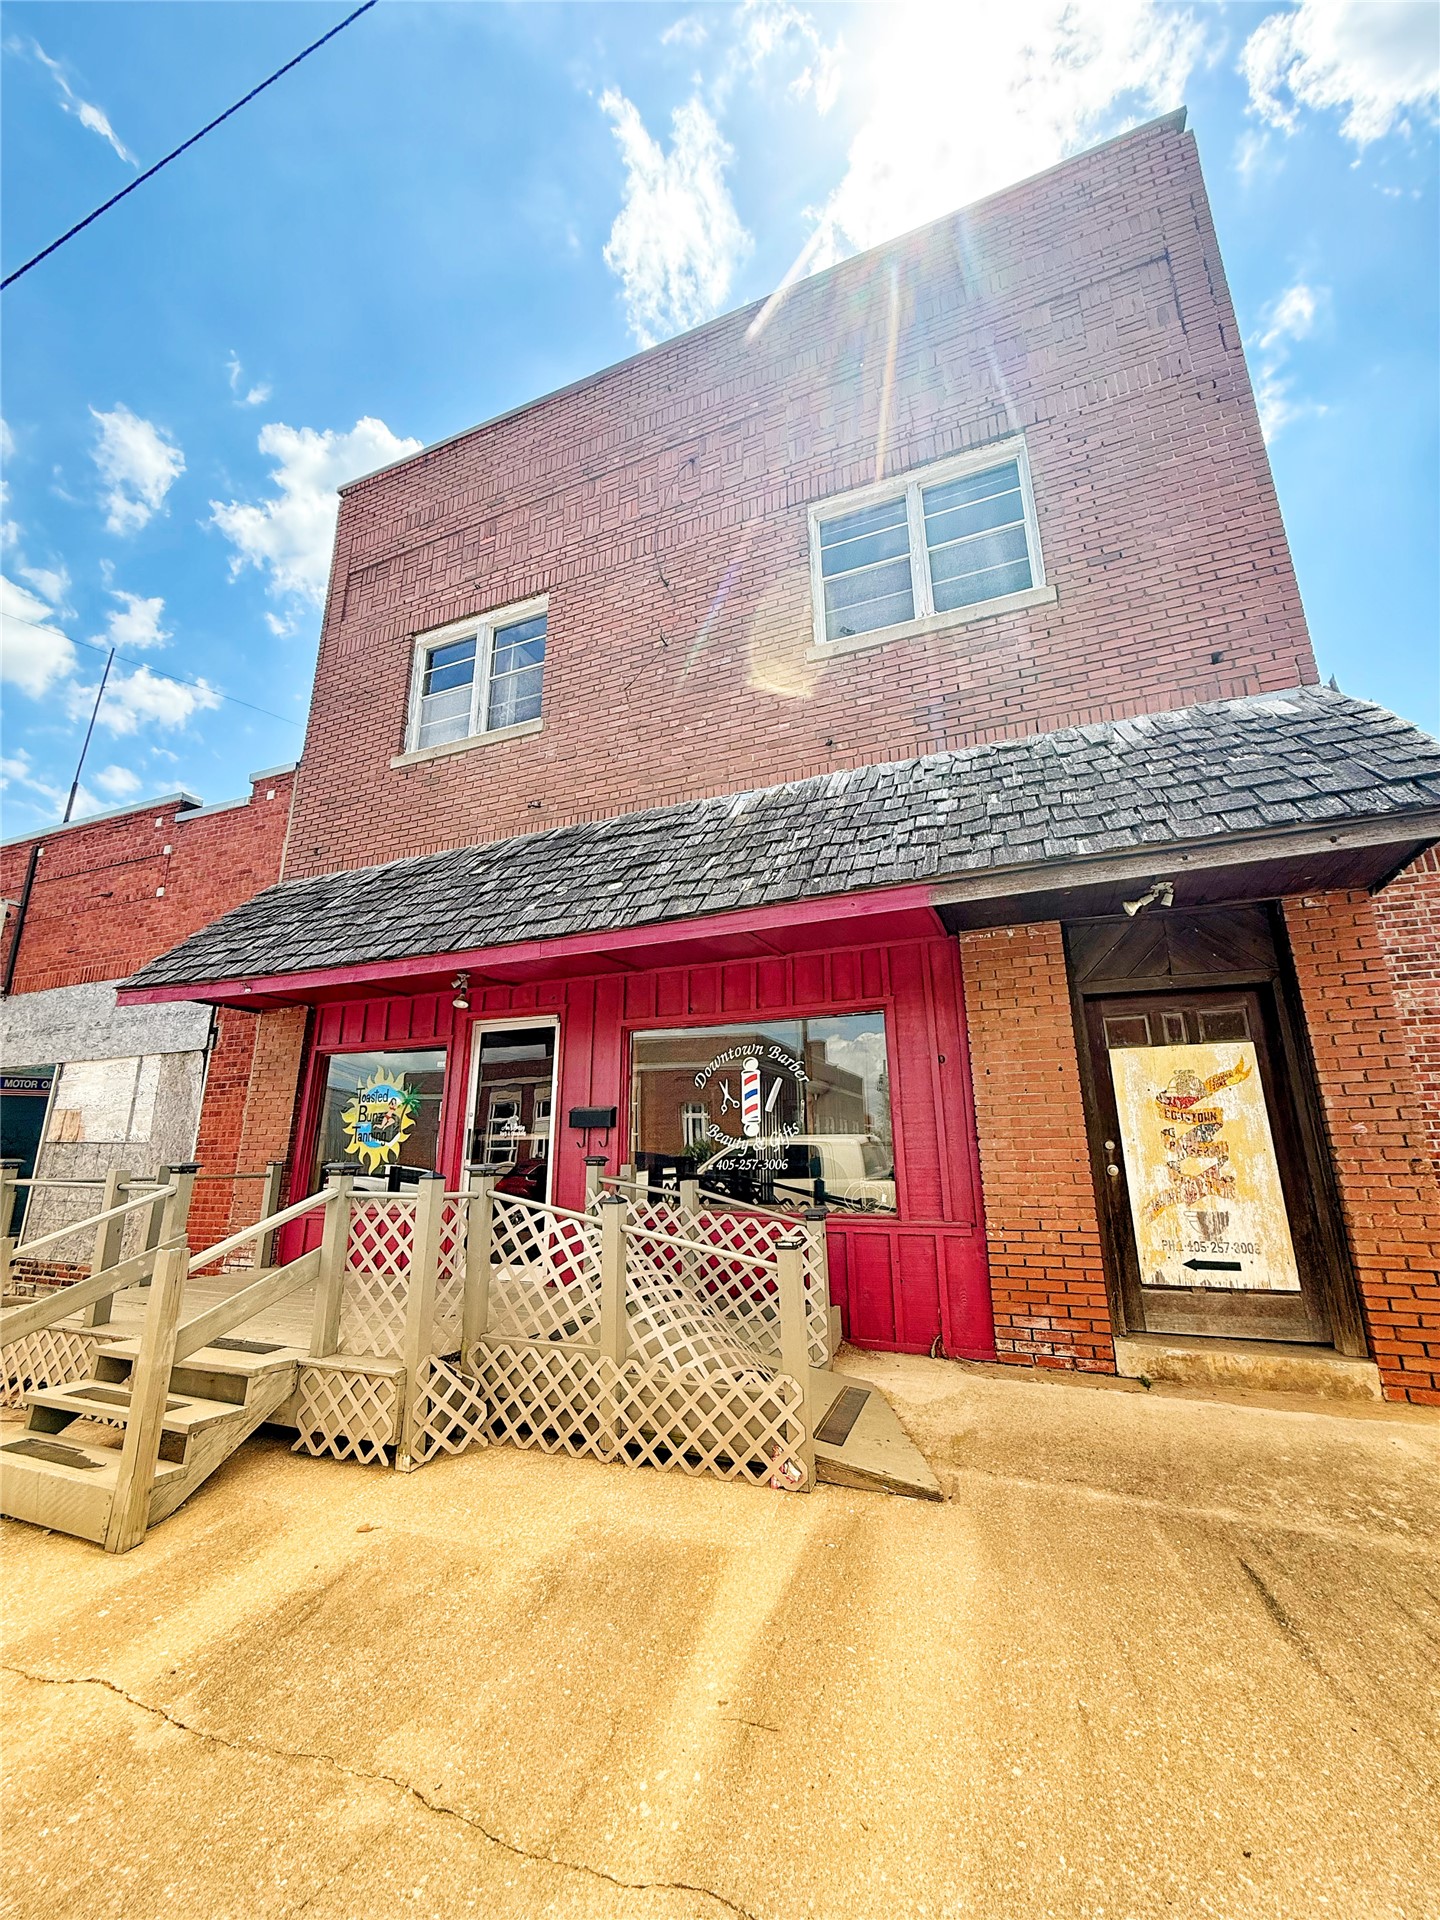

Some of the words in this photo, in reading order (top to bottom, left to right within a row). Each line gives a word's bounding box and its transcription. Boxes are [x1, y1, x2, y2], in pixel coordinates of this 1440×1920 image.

[694, 1043, 764, 1090] Downtown
[767, 1045, 811, 1083] Barber
[4, 1079, 39, 1089] MOTOR
[356, 1087, 390, 1105] Toasted
[352, 1126, 387, 1147] Tanning
[706, 1123, 749, 1157] Beauty
[752, 1138, 768, 1152] &
[770, 1122, 800, 1152] Gifts
[716, 1158, 789, 1171] 405-257-3006
